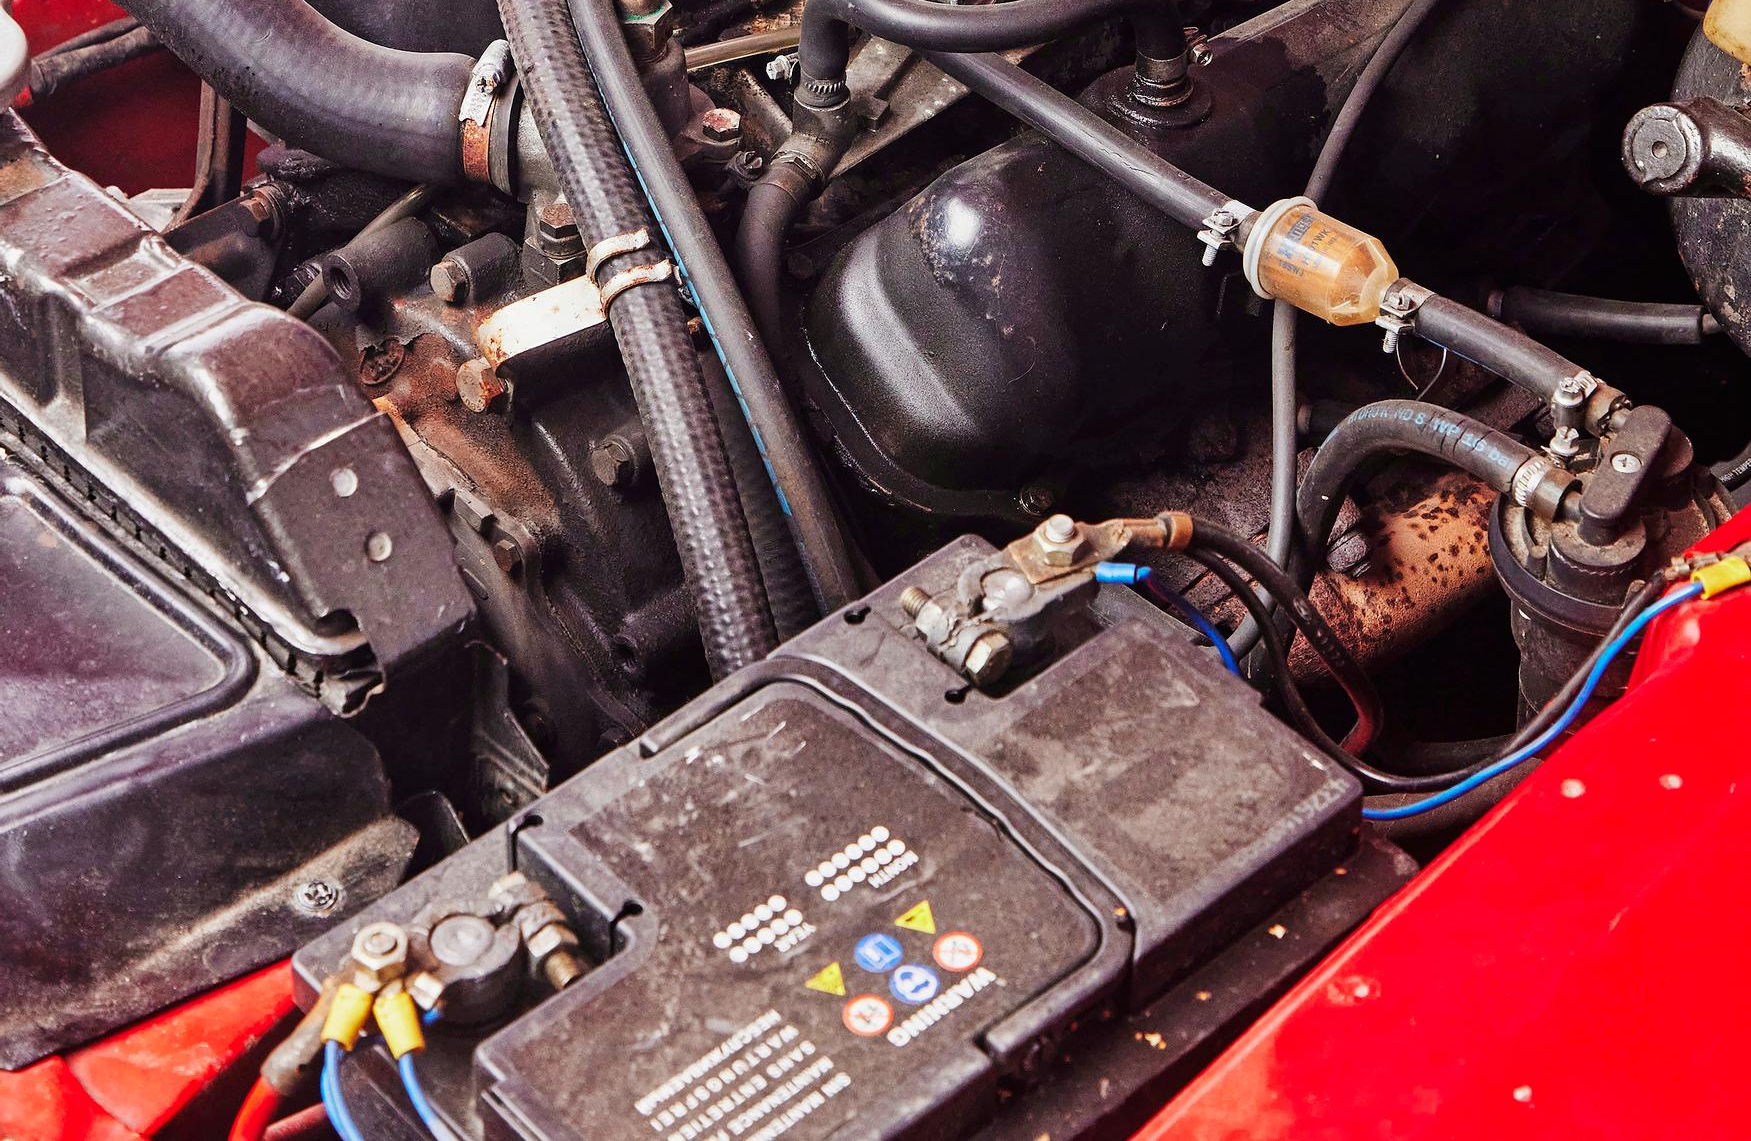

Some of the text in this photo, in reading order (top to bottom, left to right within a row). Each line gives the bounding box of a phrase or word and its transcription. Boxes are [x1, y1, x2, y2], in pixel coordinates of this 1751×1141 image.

[868, 850, 919, 888] MONTH
[774, 922, 817, 953] YEAR
[887, 967, 996, 1046] WARNING
[650, 1024, 799, 1132] WARTUNGSFREI
[766, 1040, 816, 1079] SANS
[727, 1055, 834, 1136] MAINTENANCE
